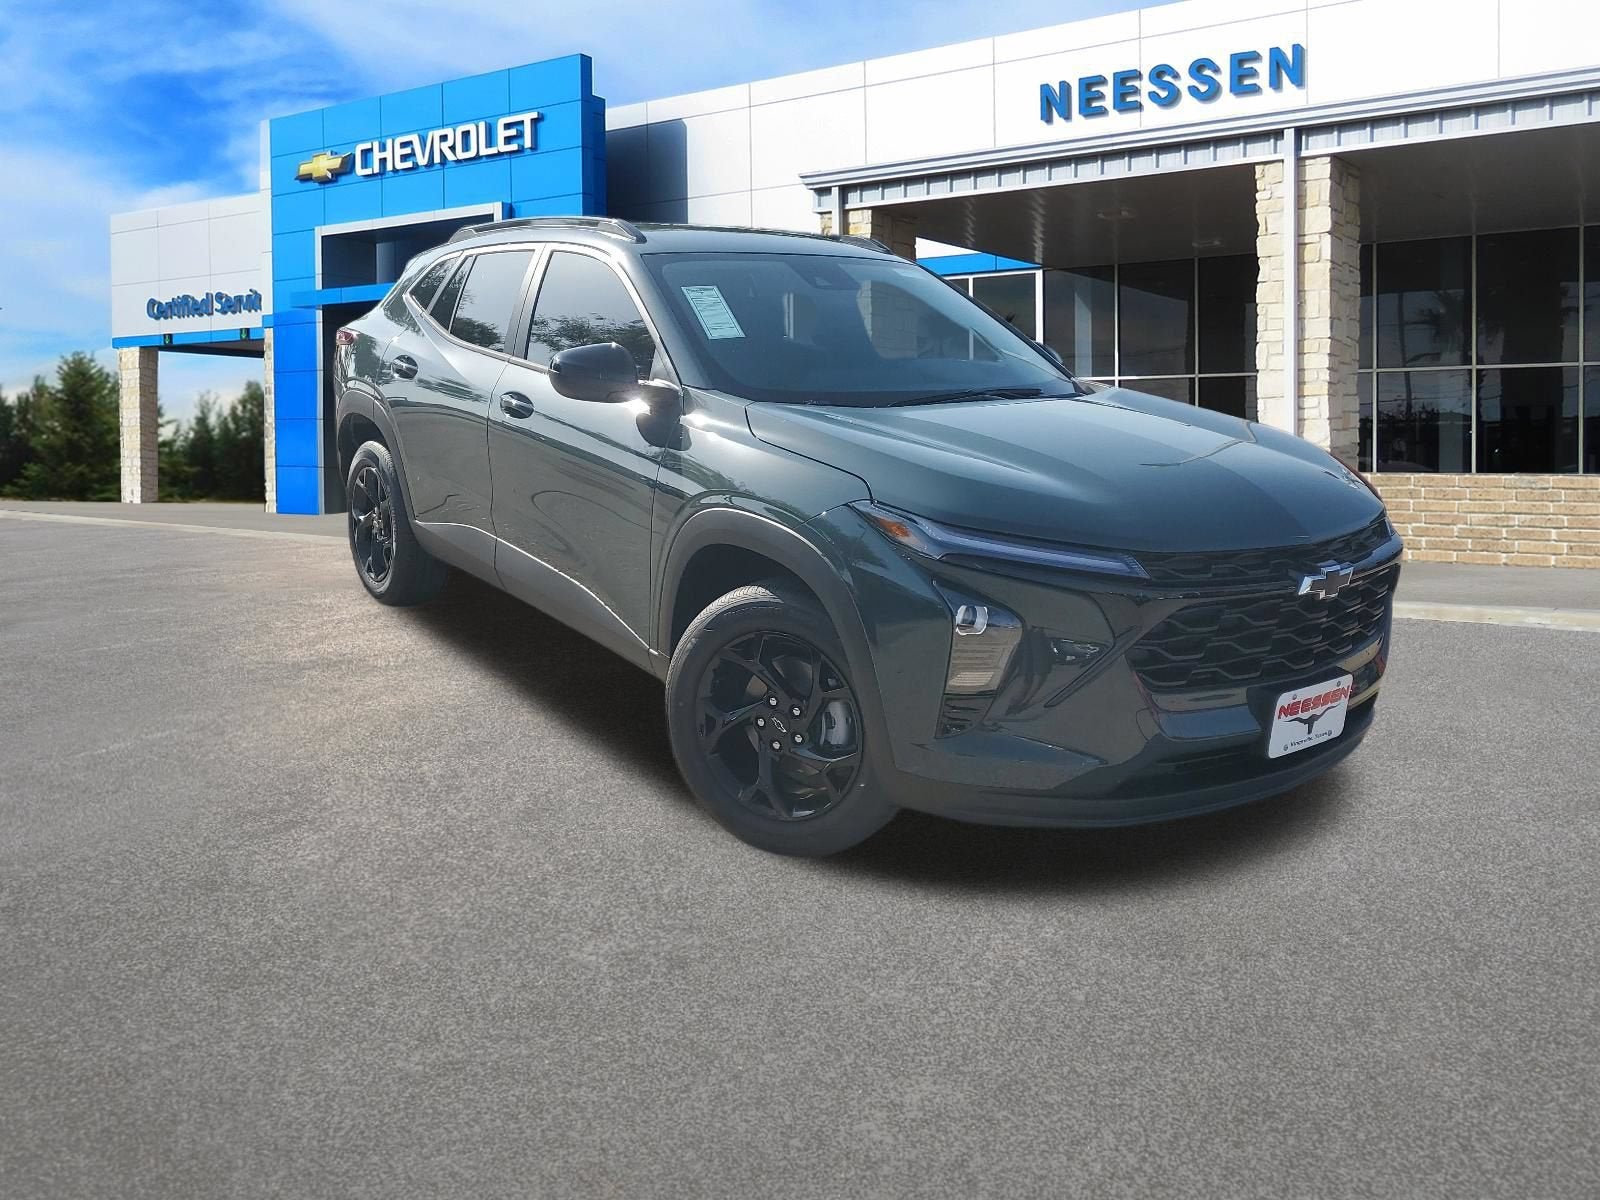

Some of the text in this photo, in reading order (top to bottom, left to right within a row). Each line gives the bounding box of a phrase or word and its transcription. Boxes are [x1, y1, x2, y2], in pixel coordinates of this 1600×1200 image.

[1039, 43, 1306, 125] NEESSEN
[354, 111, 544, 177] CHEVROLET
[146, 291, 214, 321] Certified
[1278, 685, 1351, 720] NEESSEN
